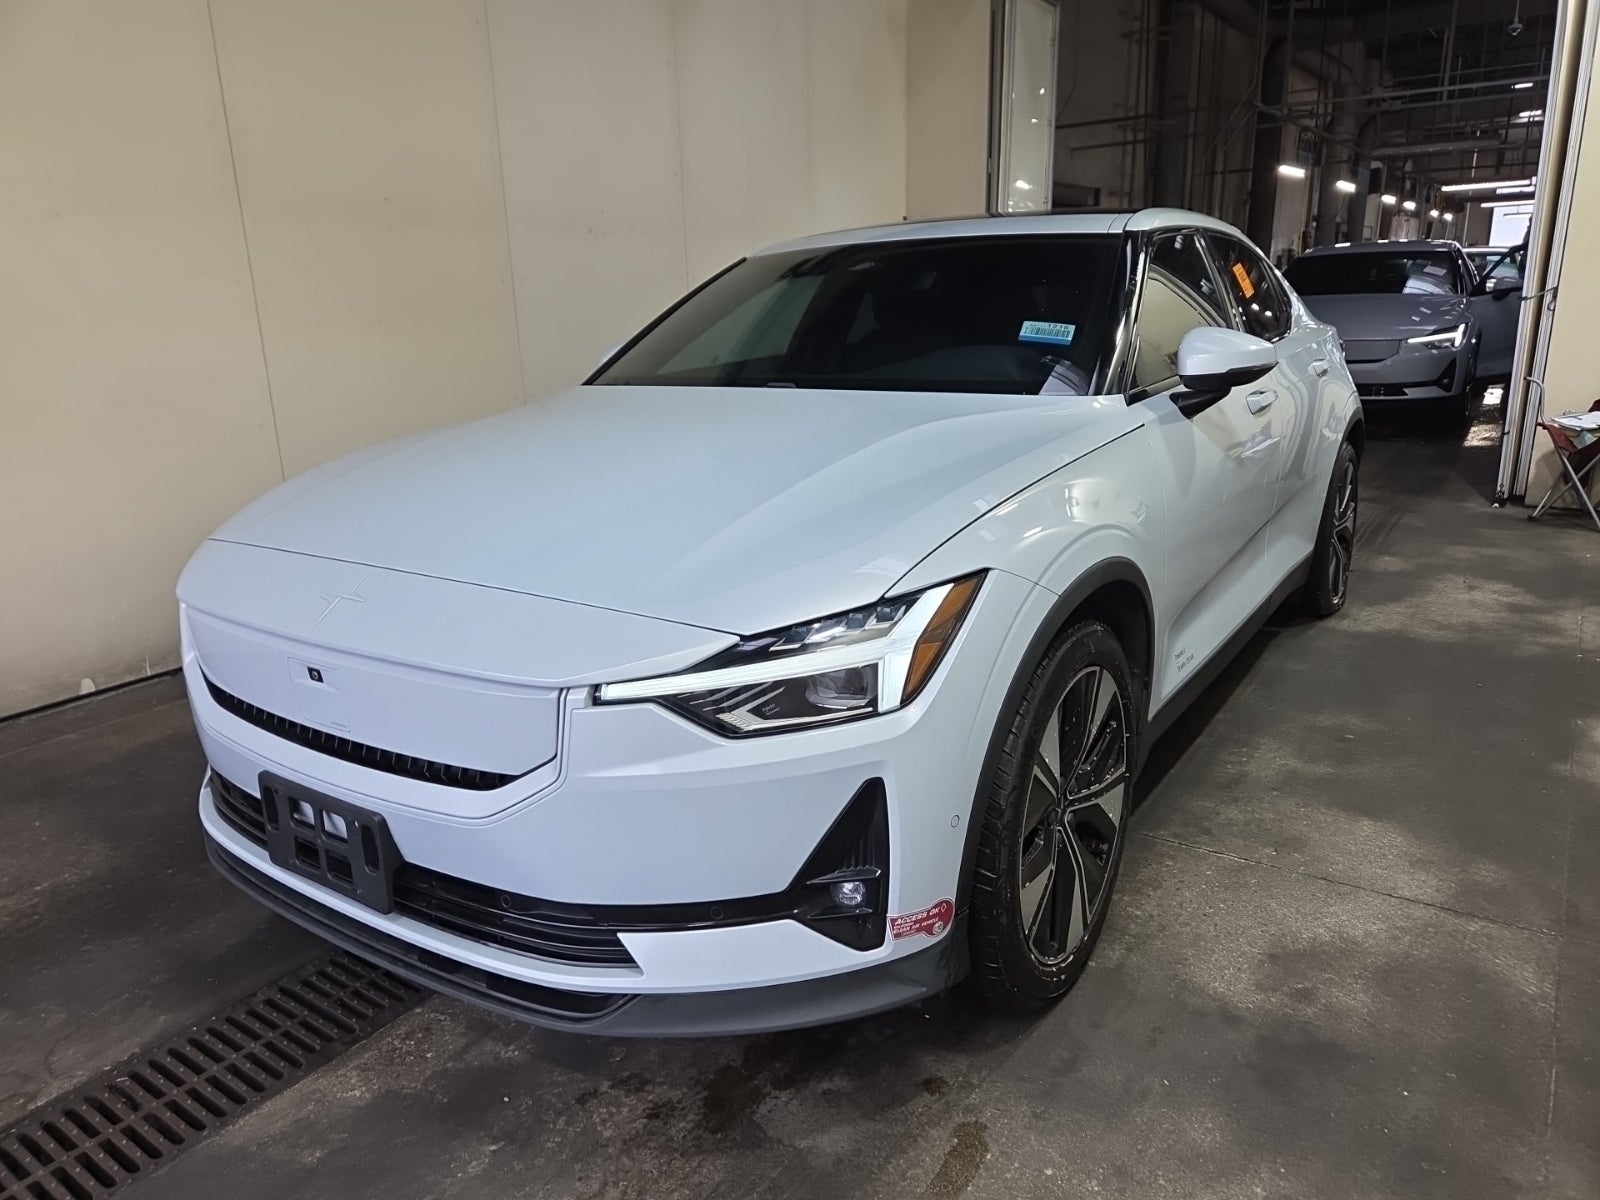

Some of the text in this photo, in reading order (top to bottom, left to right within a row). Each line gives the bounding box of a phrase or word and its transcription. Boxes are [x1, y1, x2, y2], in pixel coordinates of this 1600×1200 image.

[894, 906, 941, 925] ACCESS OK
[893, 923, 911, 934] CLEAN
